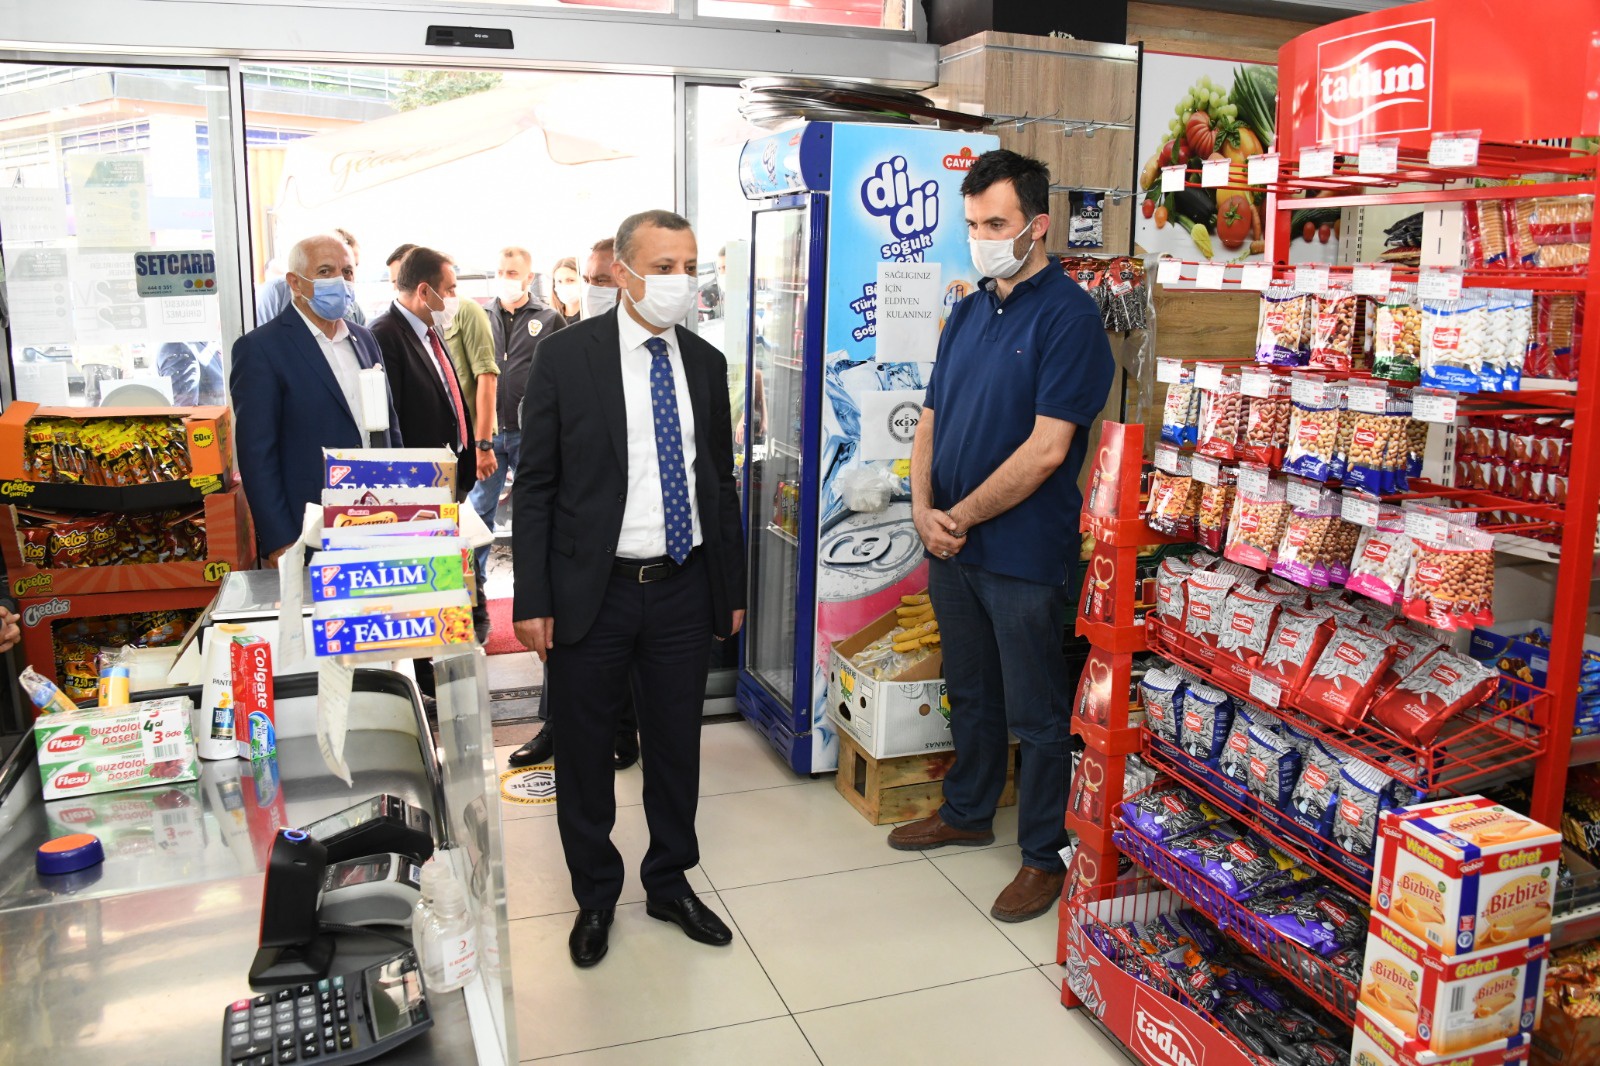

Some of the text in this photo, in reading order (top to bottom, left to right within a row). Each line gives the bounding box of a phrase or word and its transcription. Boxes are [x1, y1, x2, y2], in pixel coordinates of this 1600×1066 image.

[1320, 62, 1425, 105] tadım
[881, 234, 932, 259] soğuk
[136, 253, 215, 276] SETCARD
[1, 483, 35, 495] Cheetos
[443, 508, 455, 516] 50
[51, 532, 87, 554] Cheetos
[15, 574, 52, 596] Cheetos
[348, 566, 425, 589] FALIM
[24, 599, 70, 626] Cheetos
[353, 617, 434, 643] FALIM
[212, 678, 233, 687] PANTE
[254, 647, 268, 709] Colgate
[143, 720, 154, 732] 4
[49, 735, 84, 750] flexi
[102, 732, 139, 746] poşeti
[152, 731, 163, 744] 3
[925, 740, 953, 749] NANAS
[57, 772, 90, 787] flexi
[107, 768, 145, 783] poşeti
[1405, 837, 1444, 870] Wafers
[1498, 848, 1542, 869] Gofret
[1403, 875, 1442, 903] Bizbize
[1491, 879, 1548, 914] Bizbize
[1381, 925, 1418, 960] Wafers
[1375, 962, 1414, 991] Bizbize
[1455, 957, 1499, 978] Gofret
[1477, 977, 1516, 999] Bizbize
[1364, 1019, 1395, 1056] Wafers
